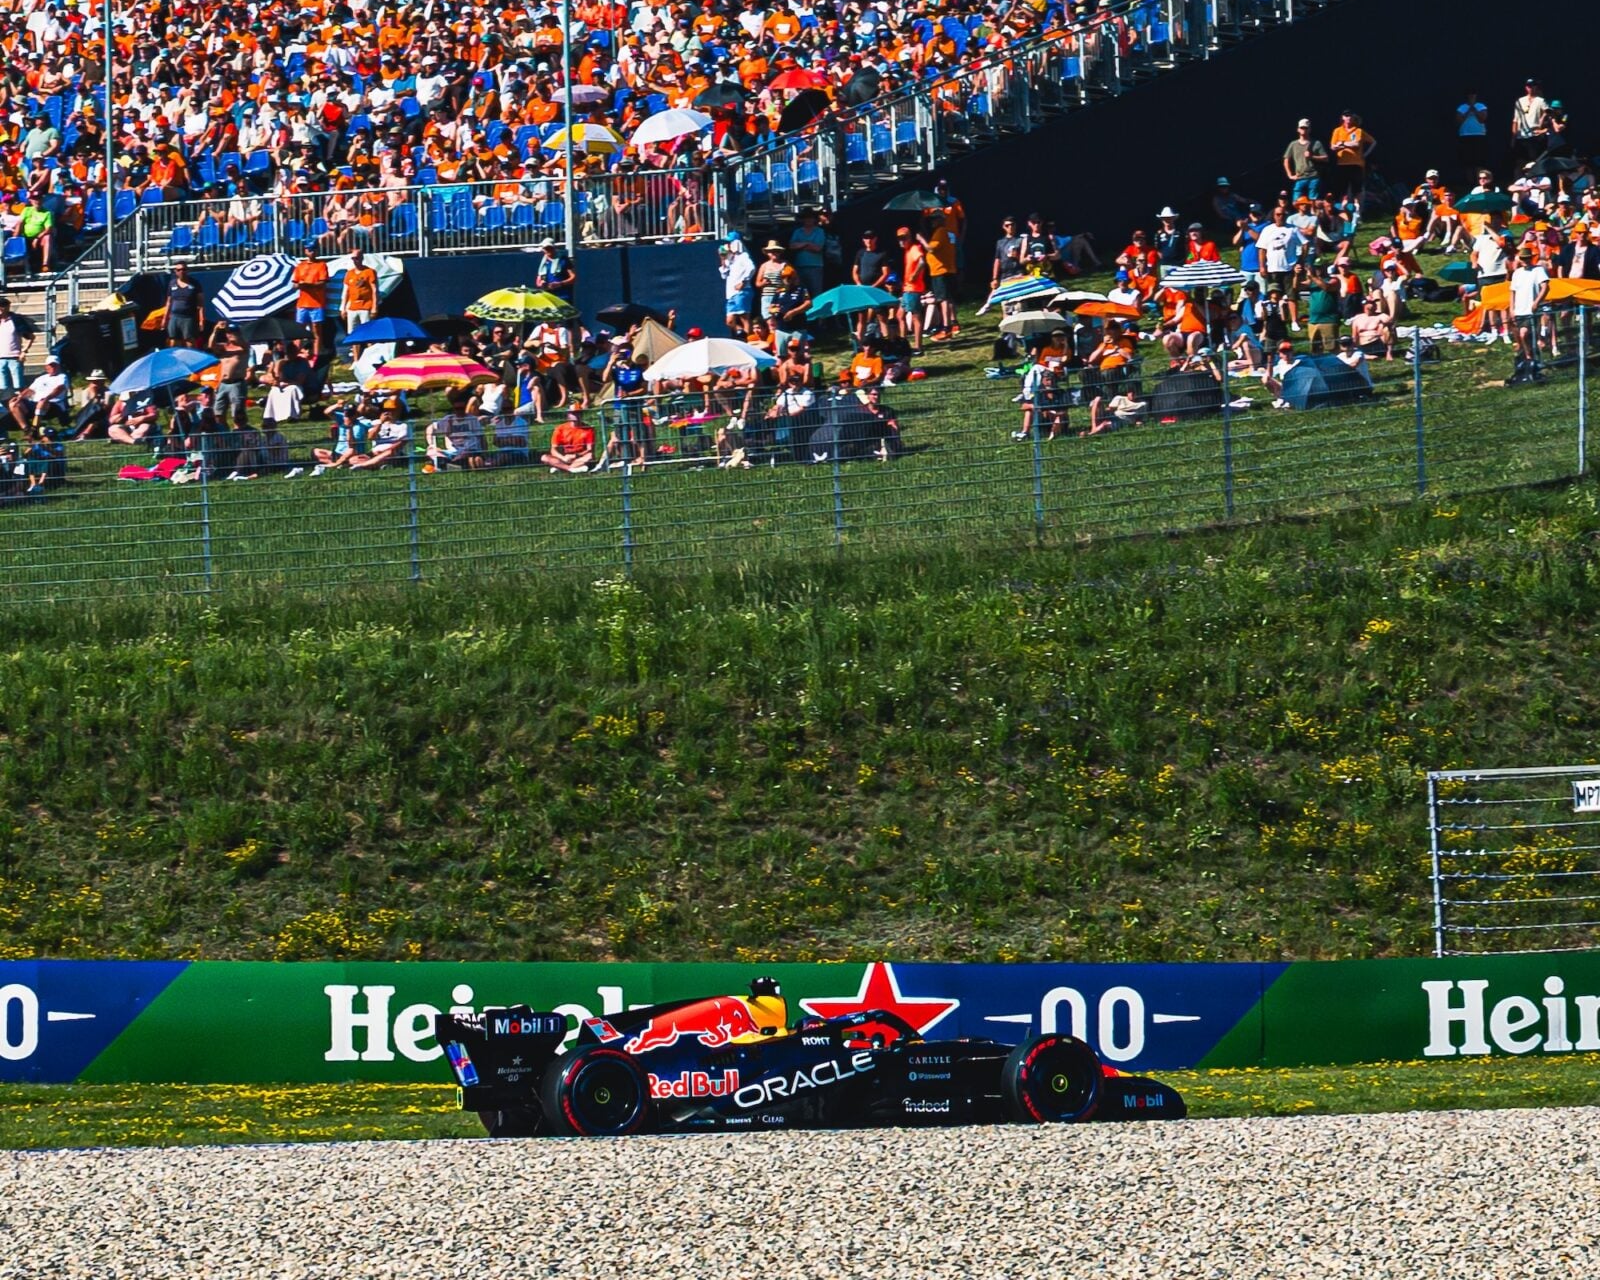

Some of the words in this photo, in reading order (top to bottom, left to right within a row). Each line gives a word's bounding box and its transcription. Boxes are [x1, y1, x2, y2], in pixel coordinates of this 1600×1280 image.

[494, 1018, 541, 1035] Mobil
[802, 1037, 830, 1045] ROKT
[908, 1056, 951, 1064] CARLYLE
[648, 1071, 690, 1099] Red
[692, 1069, 740, 1097] Bull
[734, 1051, 876, 1108] ORACLE
[902, 1097, 950, 1113] indeed
[1123, 1094, 1163, 1108] Mobil
